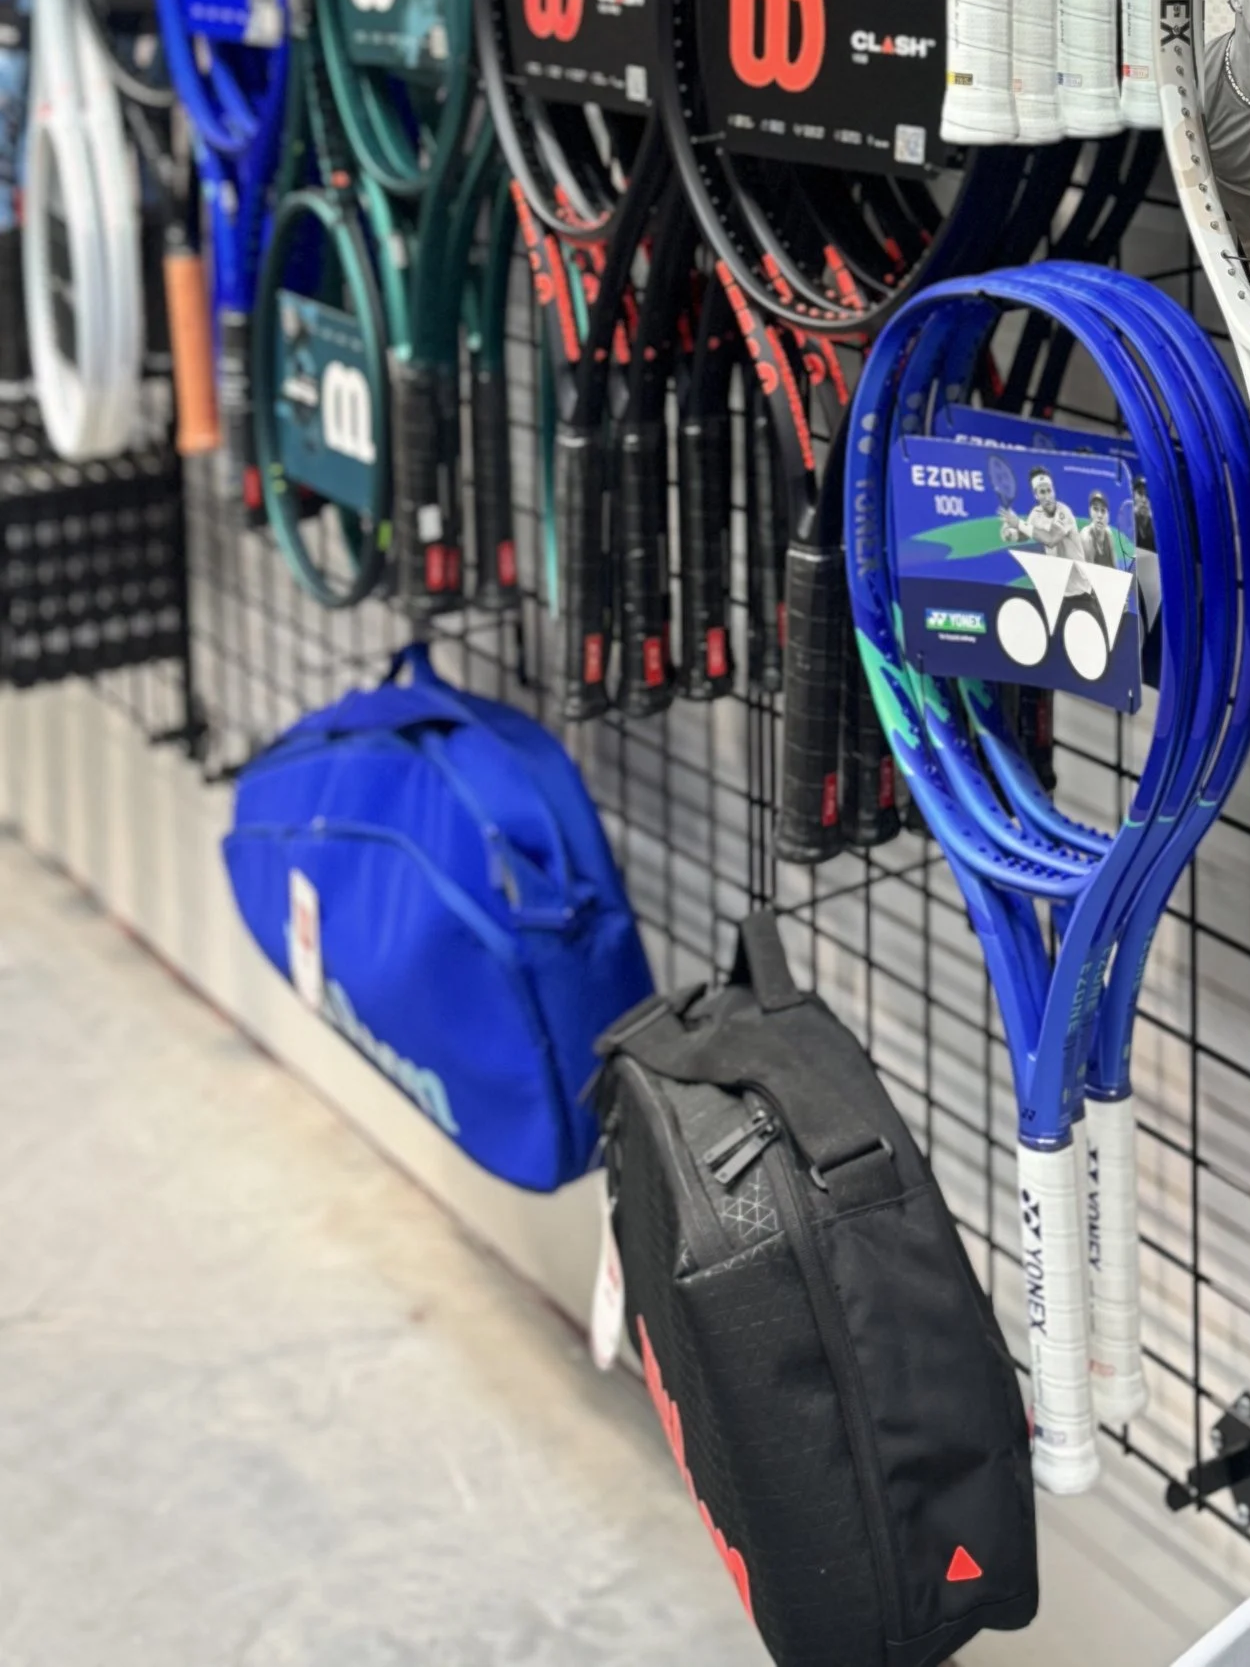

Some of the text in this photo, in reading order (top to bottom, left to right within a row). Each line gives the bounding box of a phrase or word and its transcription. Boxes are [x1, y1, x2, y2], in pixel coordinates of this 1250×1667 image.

[911, 464, 985, 492] EZONE
[934, 495, 968, 517] 100L
[948, 614, 982, 629] YONEX
[1028, 1250, 1049, 1336] YONEX
